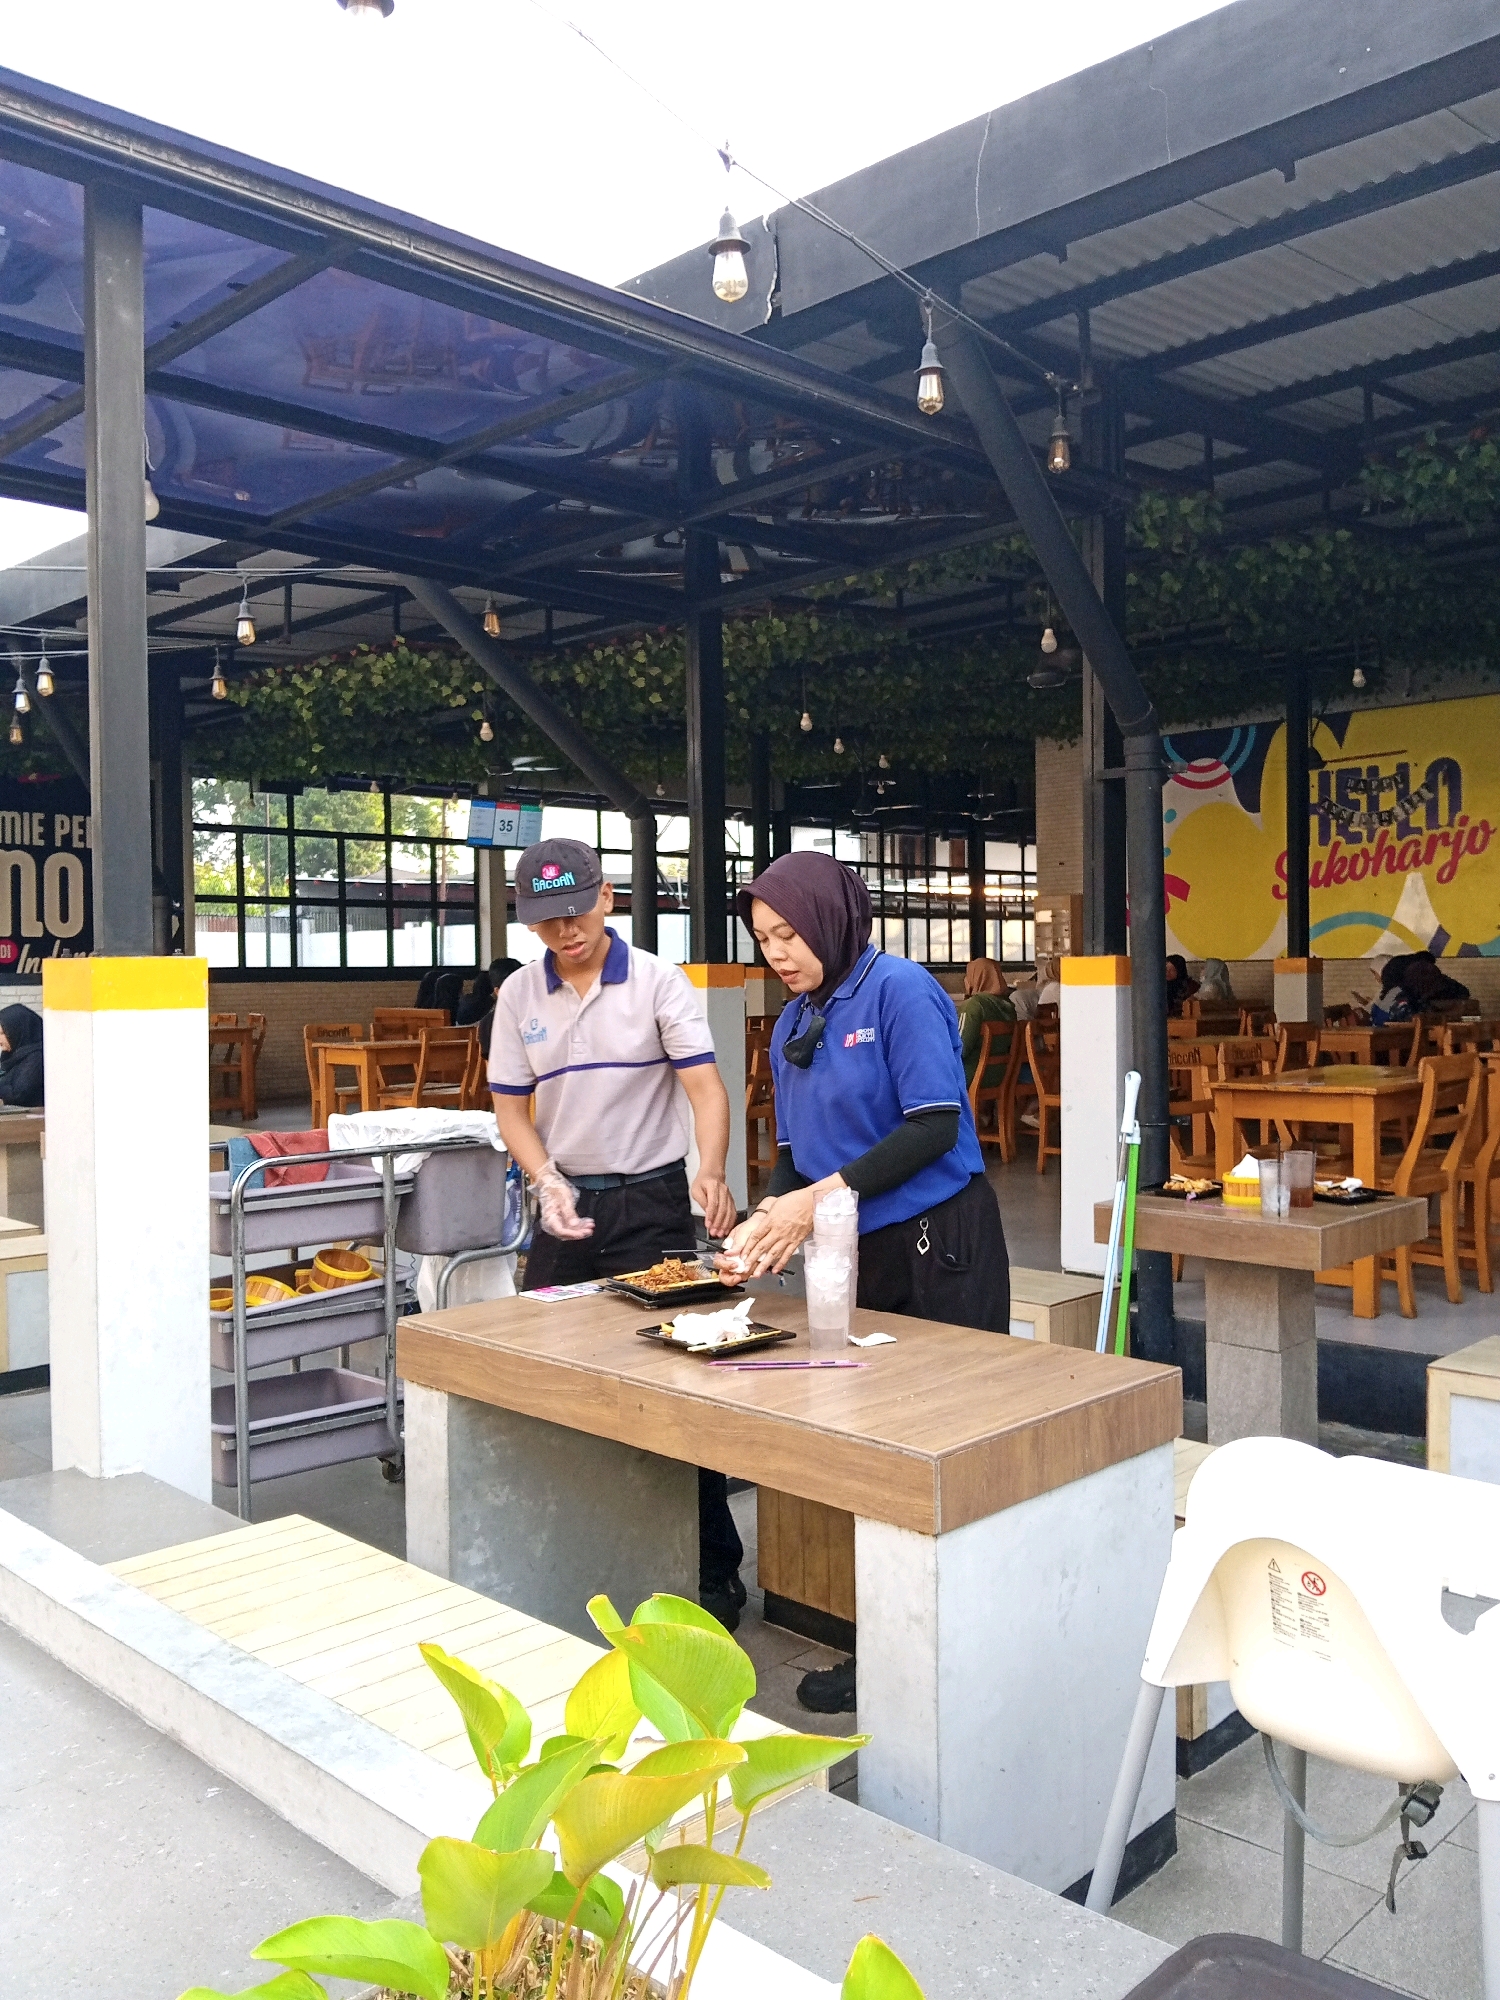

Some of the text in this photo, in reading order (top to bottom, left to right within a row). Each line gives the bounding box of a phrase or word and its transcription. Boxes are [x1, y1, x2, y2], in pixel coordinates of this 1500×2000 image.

[0, 811, 45, 847] MIE
[499, 819, 514, 833] 35
[532, 872, 576, 893] GACOAN
